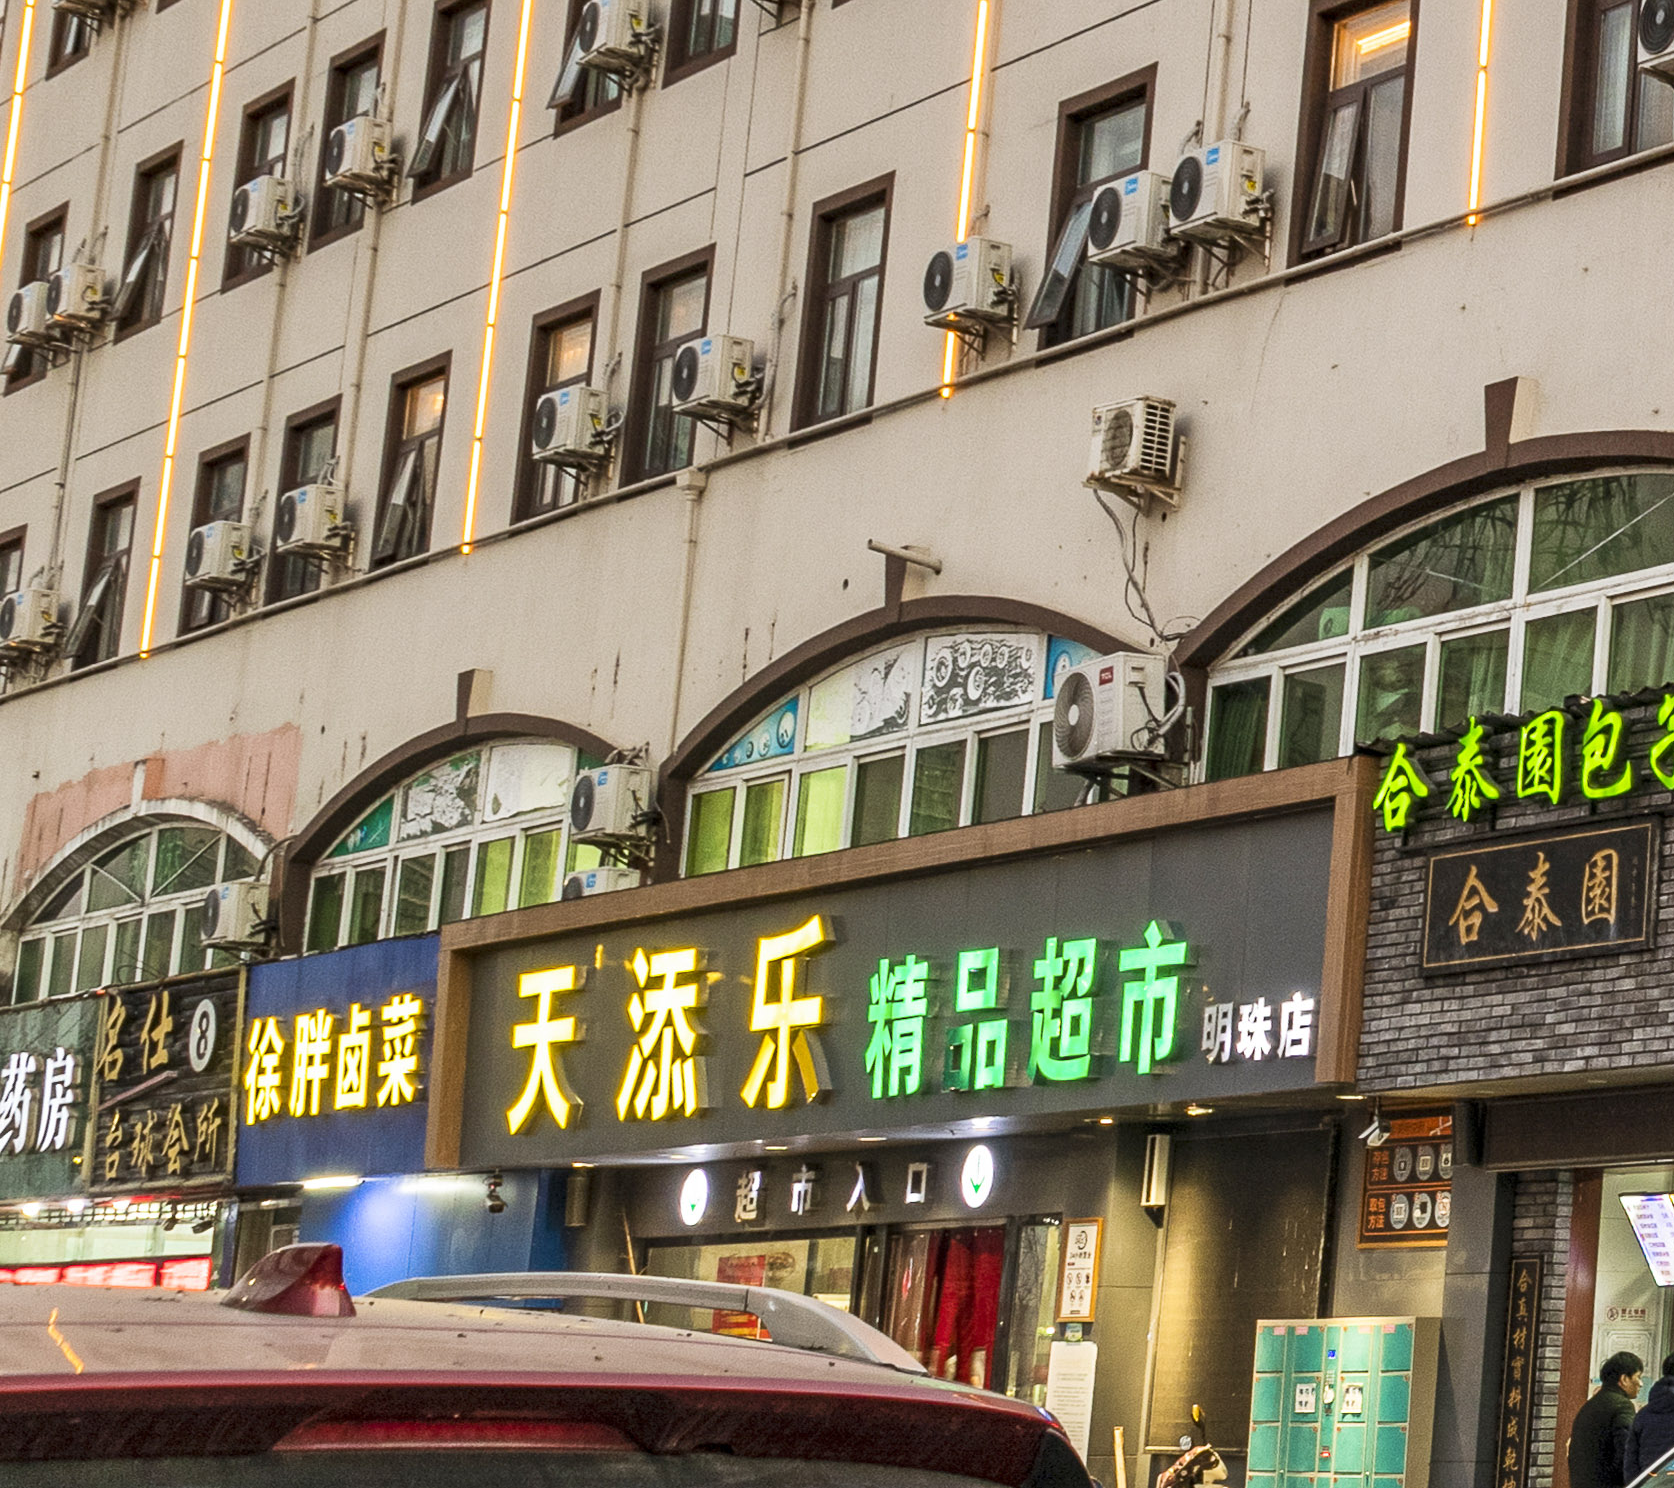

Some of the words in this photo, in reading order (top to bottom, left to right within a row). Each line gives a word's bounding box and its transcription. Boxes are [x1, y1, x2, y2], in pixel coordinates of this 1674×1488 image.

[98, 989, 174, 1082] 名仕
[243, 991, 423, 1126] 徐胖卤菜
[507, 913, 838, 1135] 天添乐
[863, 919, 1188, 1100] 精品超市
[1201, 991, 1316, 1064] 明珠店
[0, 1046, 77, 1155] 药房
[104, 1097, 222, 1181] 台球会所
[734, 1160, 929, 1223] 超市入口
